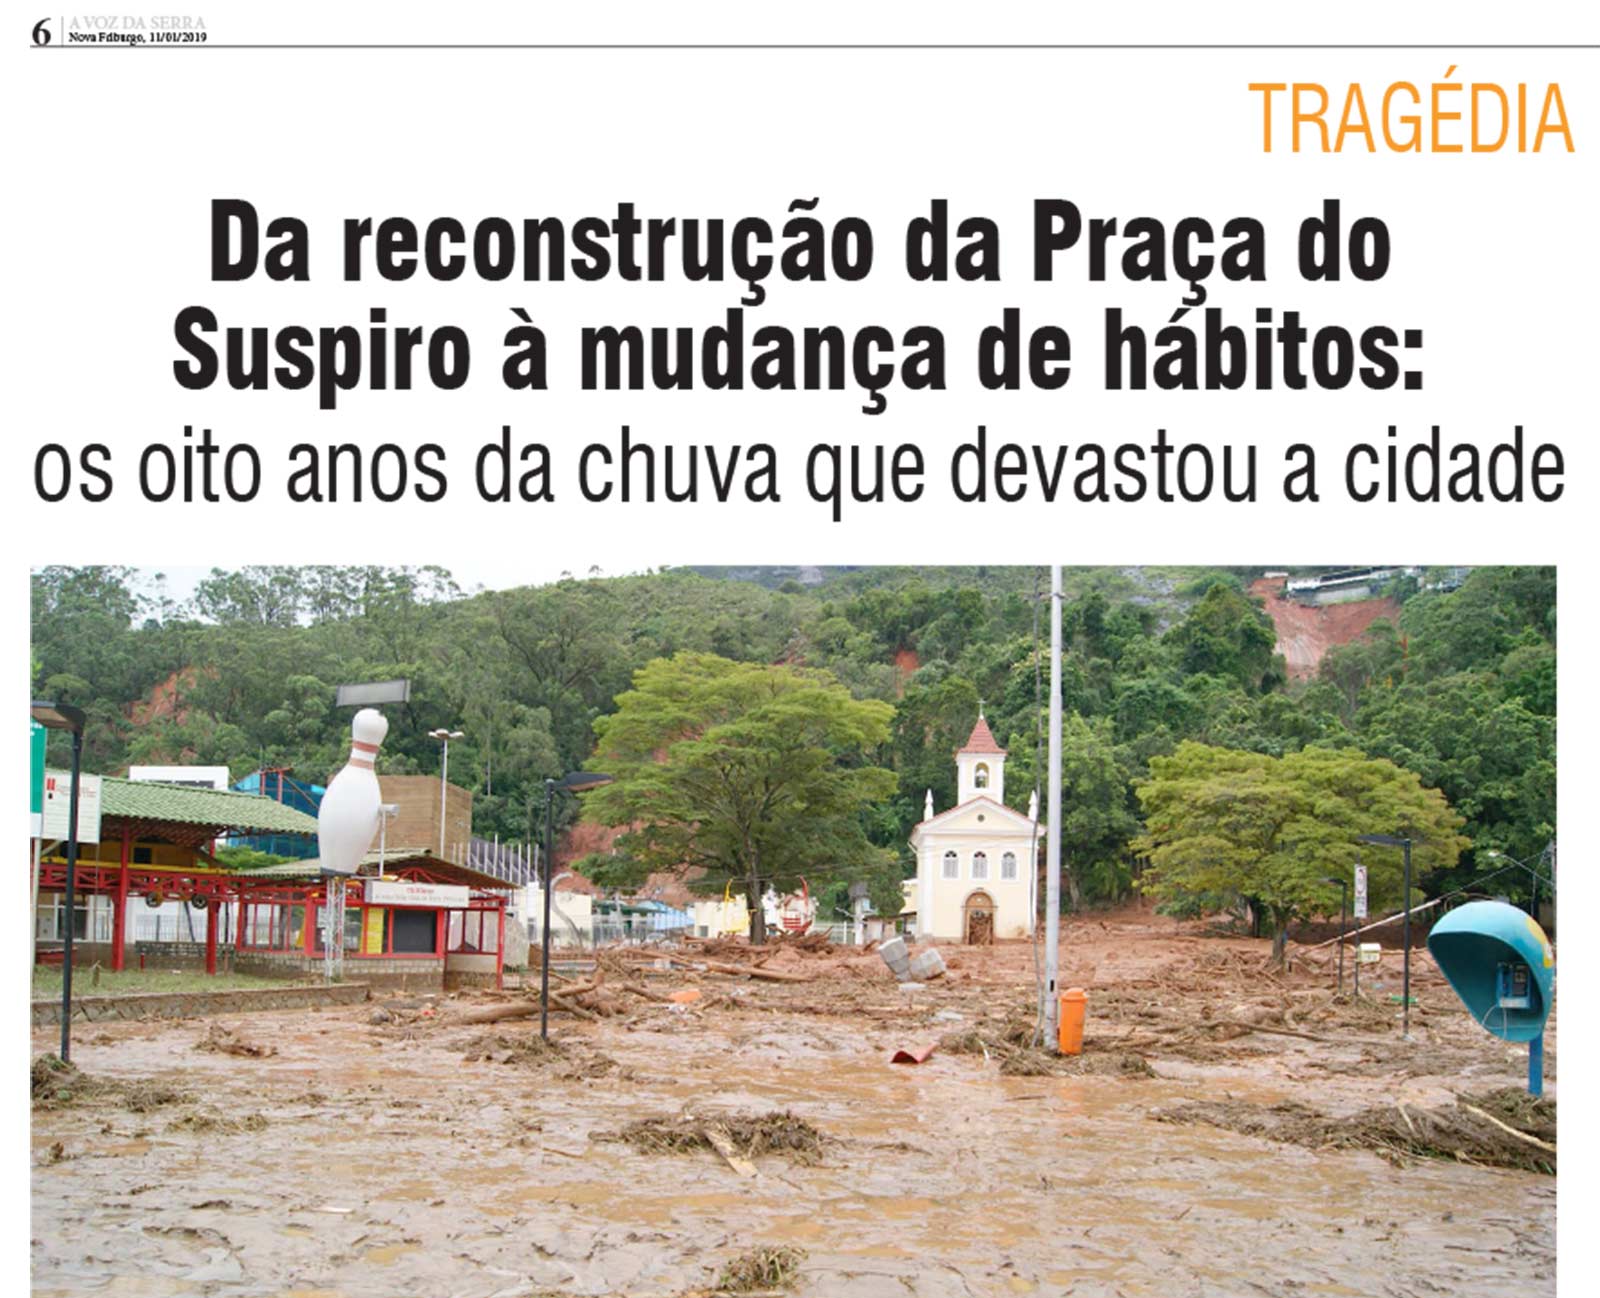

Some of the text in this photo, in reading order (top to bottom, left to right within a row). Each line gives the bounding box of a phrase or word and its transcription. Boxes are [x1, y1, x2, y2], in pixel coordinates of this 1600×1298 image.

[32, 18, 51, 45] 6
[69, 32, 96, 42] Nova
[150, 32, 207, 42] 11/01/2019
[70, 16, 205, 29] A VOZ DA SERRA
[1248, 65, 1575, 153] TRAGÉDIA
[211, 197, 1391, 305] Da reconstrução da Praça do
[173, 306, 1423, 415] Suspiro à mudança de hábitos:
[34, 425, 1564, 522] os oito anos da chuva que devastou a cidade
